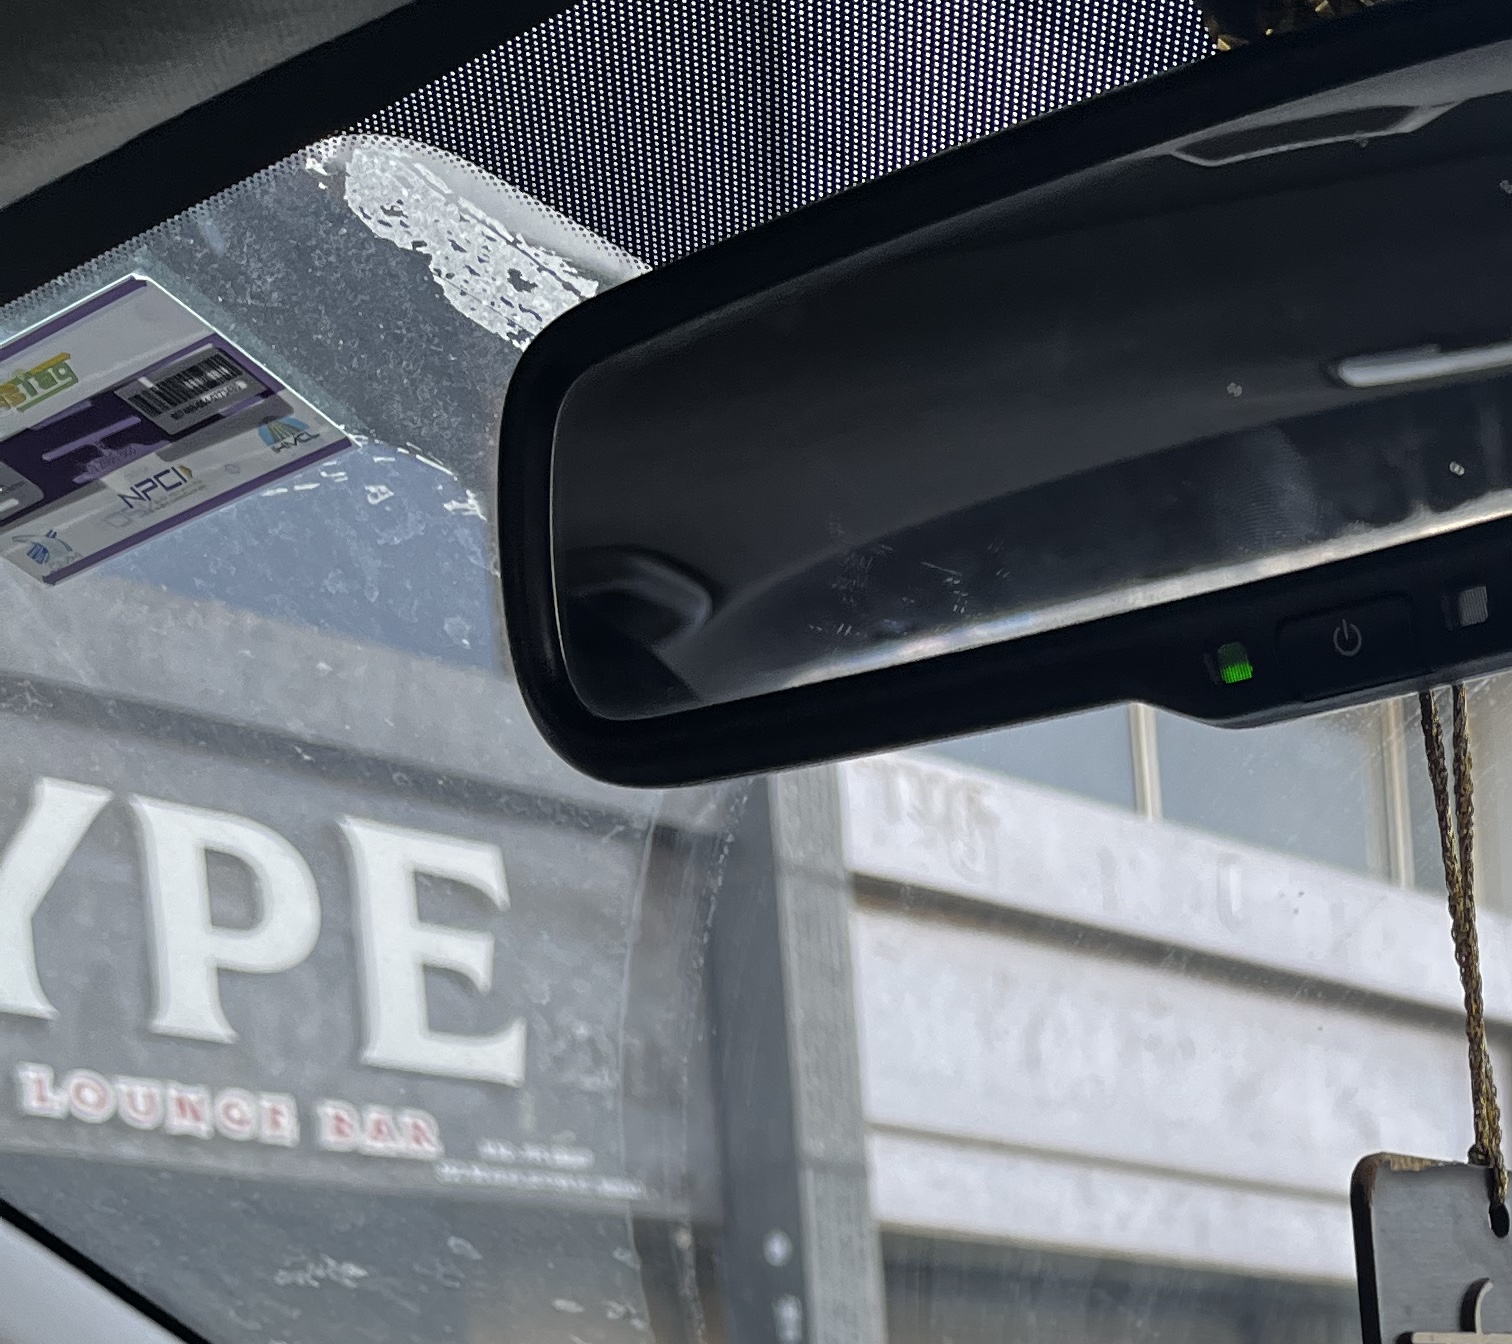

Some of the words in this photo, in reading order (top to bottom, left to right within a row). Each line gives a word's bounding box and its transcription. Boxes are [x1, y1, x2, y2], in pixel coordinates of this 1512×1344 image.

[117, 466, 189, 509] NPCI
[14, 1061, 299, 1148] LOUNGE
[313, 1098, 445, 1161] BAR
